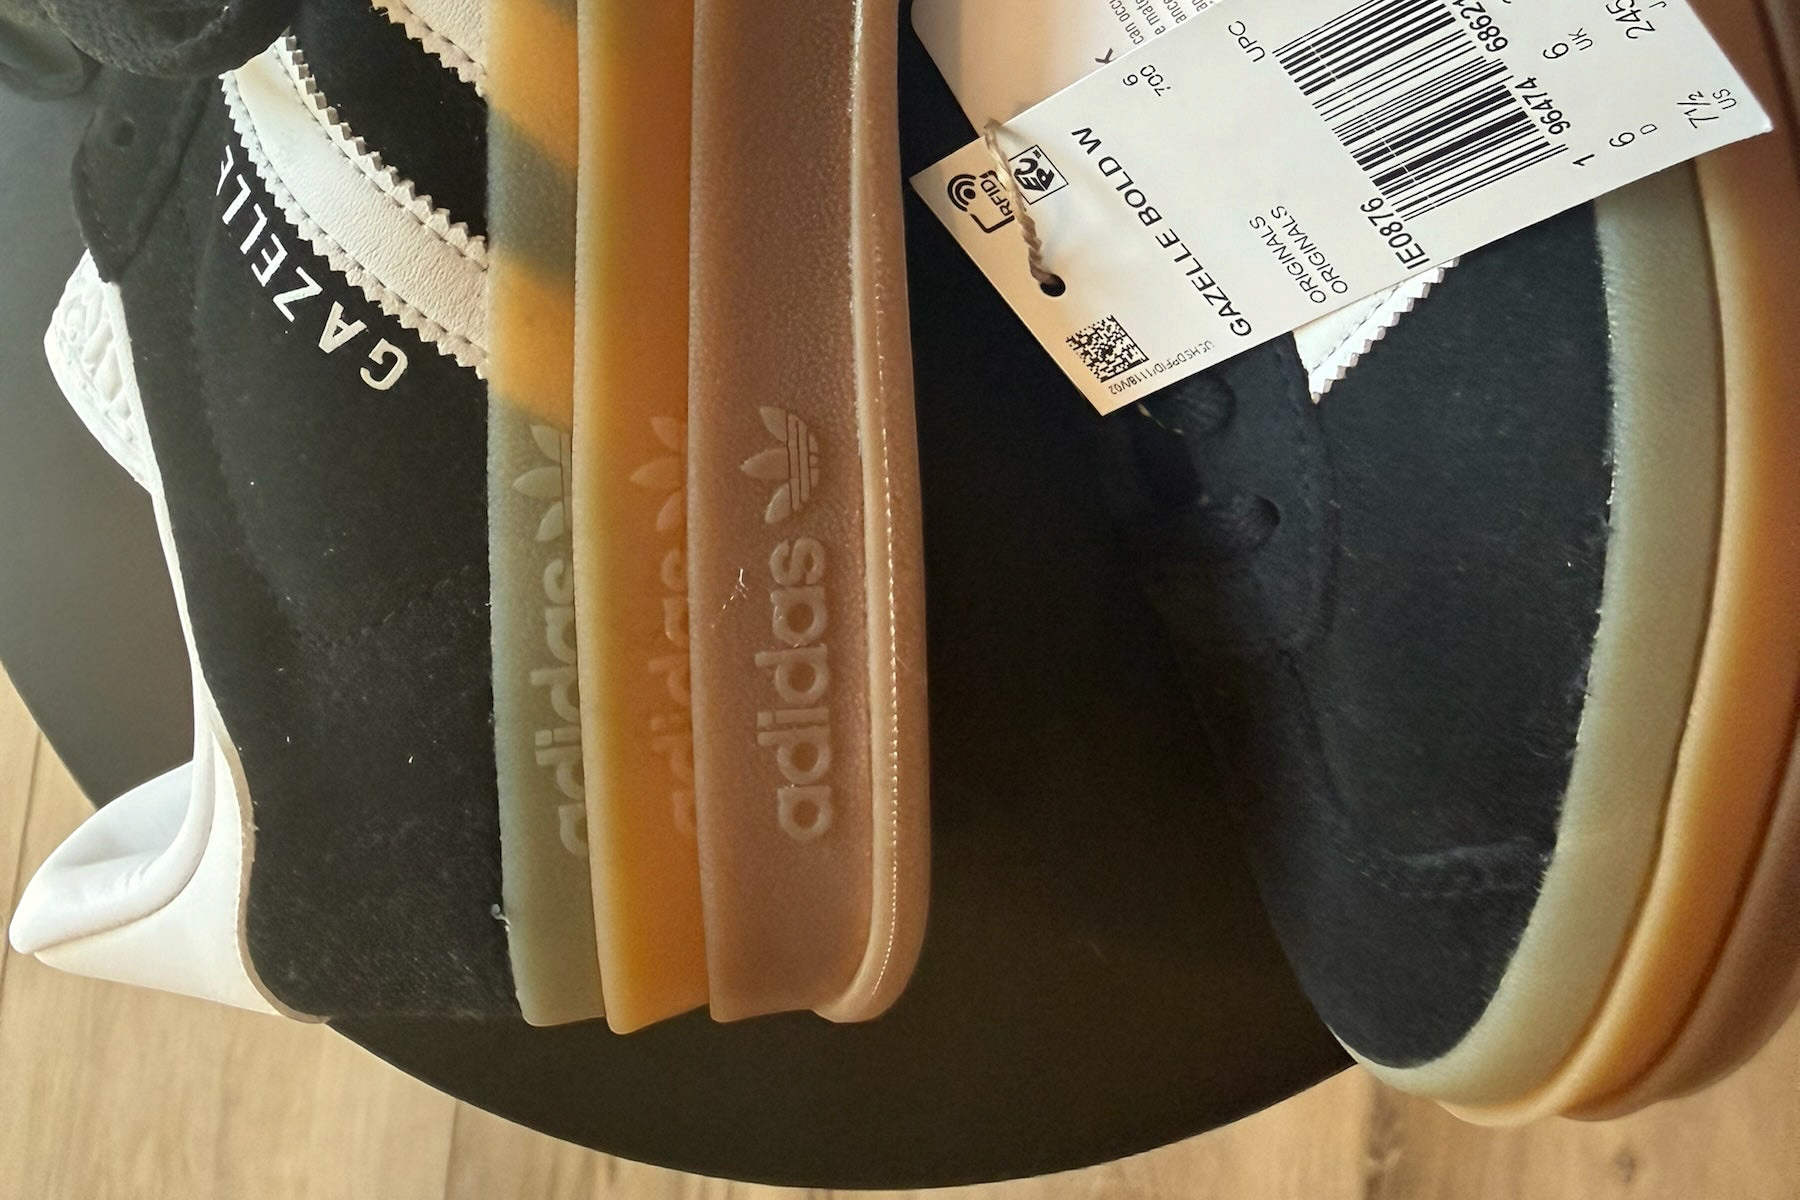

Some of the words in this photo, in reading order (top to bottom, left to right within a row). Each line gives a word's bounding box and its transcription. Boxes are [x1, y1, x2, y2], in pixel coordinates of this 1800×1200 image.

[1228, 20, 1266, 63] UPC
[1542, 42, 1570, 60] 6
[1568, 27, 1594, 51] UK
[1122, 74, 1139, 87] 6
[1712, 88, 1737, 110] US
[1514, 76, 1571, 135] 96474
[1071, 127, 1102, 155] W
[1572, 153, 1595, 167] 1
[1608, 132, 1636, 148] 6
[980, 179, 1014, 217] RFID
[1098, 156, 1163, 227] BOLD
[1270, 205, 1349, 294] ORIGINALS
[1360, 197, 1432, 270] IE0876
[1249, 216, 1327, 304] ORIGINALS
[1154, 228, 1252, 337] GAZELLE
[754, 536, 833, 843] adidas
